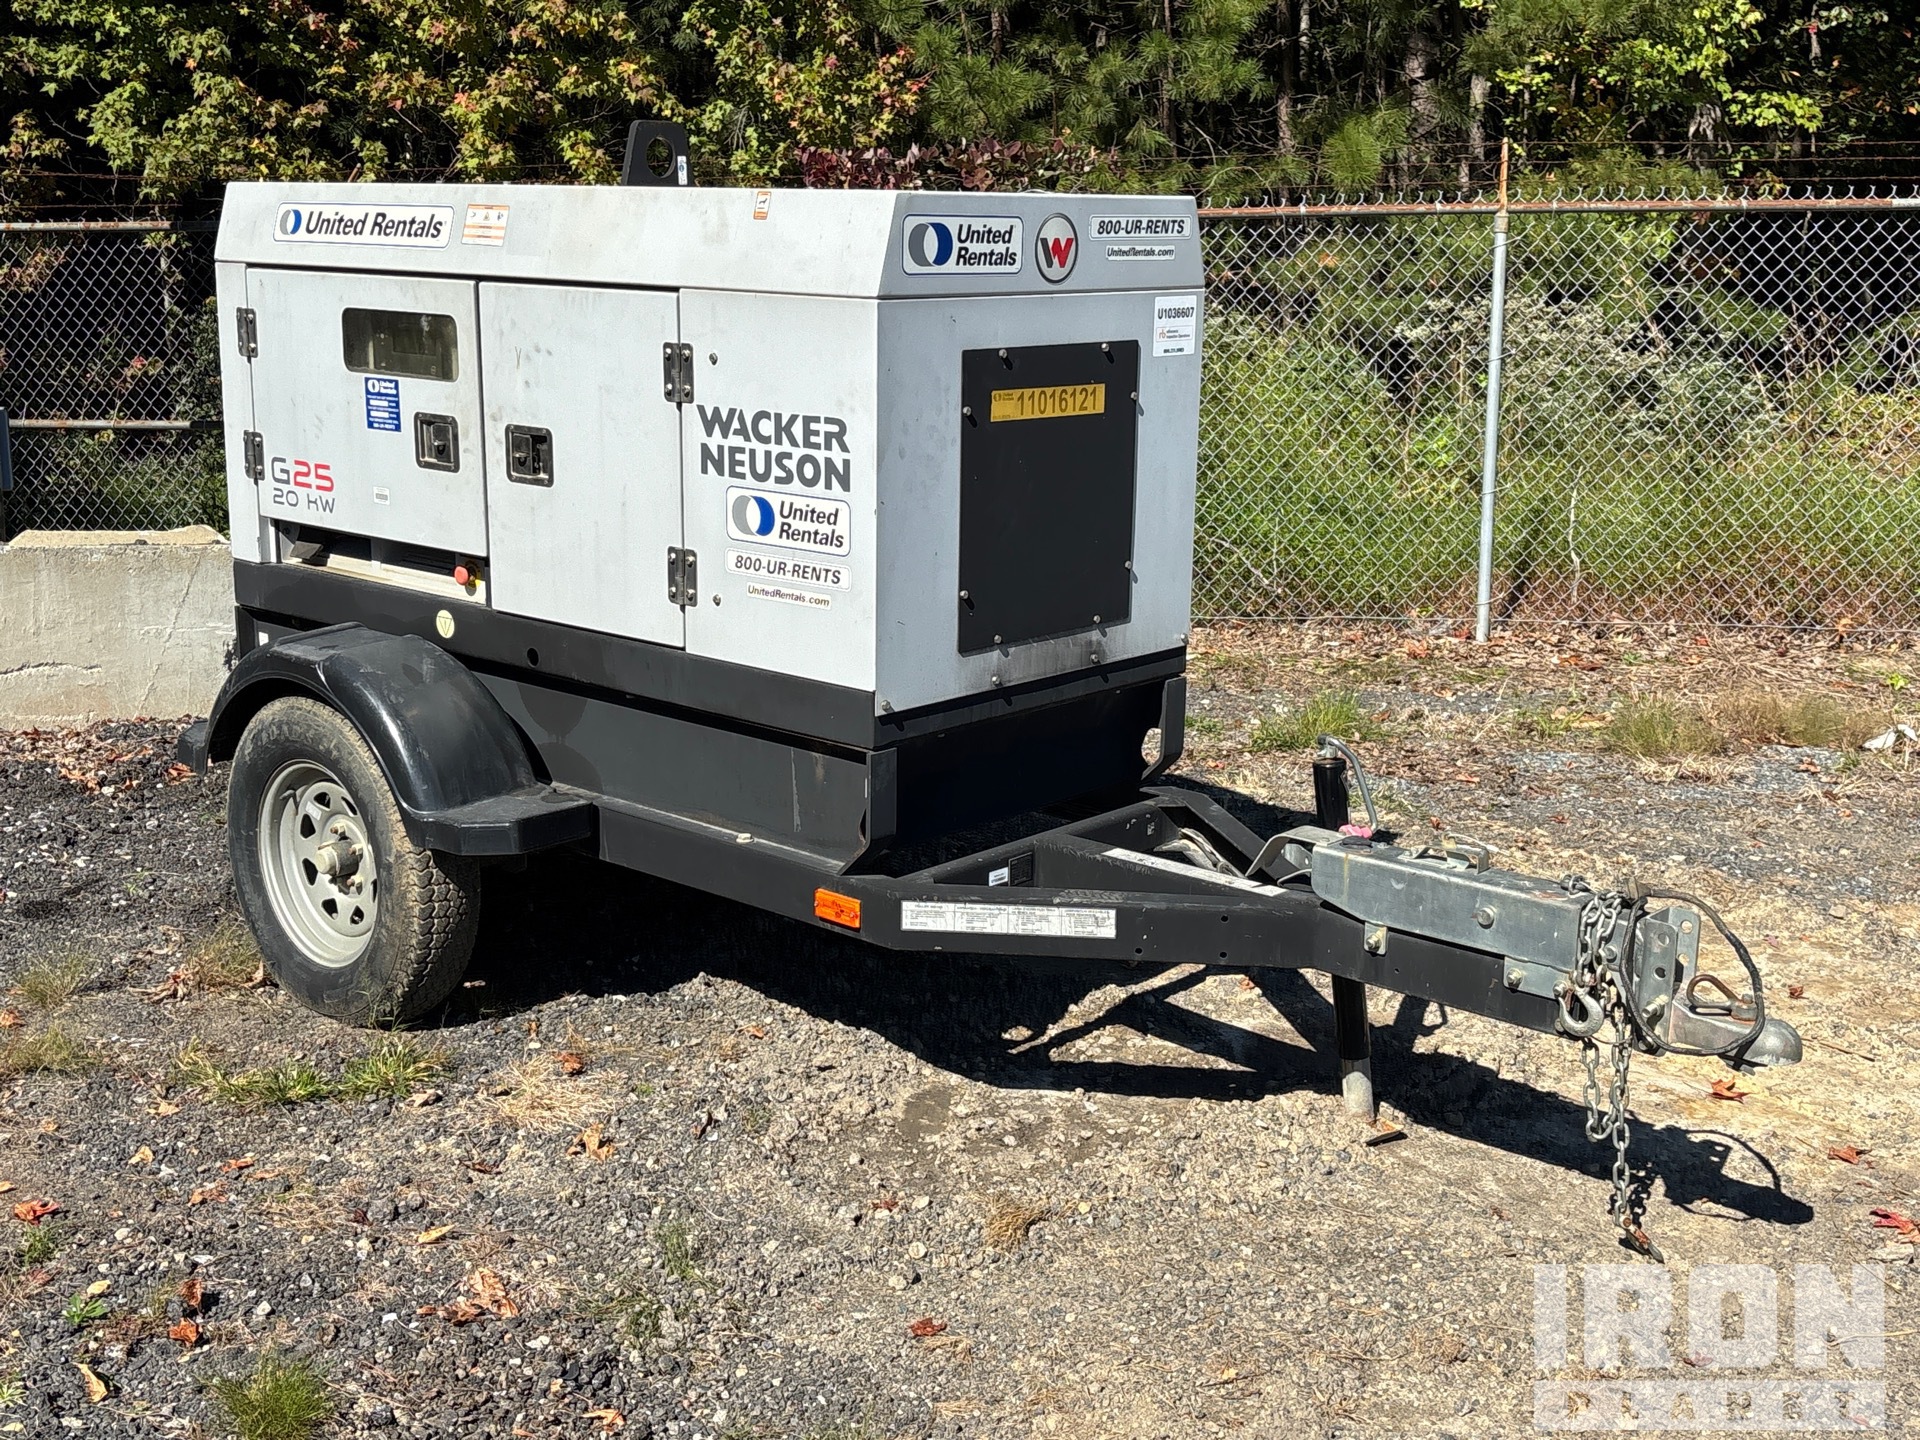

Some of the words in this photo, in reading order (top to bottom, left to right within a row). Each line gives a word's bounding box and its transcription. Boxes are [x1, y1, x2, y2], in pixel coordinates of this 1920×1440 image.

[306, 211, 369, 236] United
[369, 212, 443, 239] Rentals
[957, 224, 1014, 244] United
[1097, 219, 1185, 235] 800-UR-RENTS
[956, 246, 1018, 266] Rentals
[1107, 247, 1174, 257] UnitedRentals.com
[1157, 306, 1195, 320] U1036607
[1017, 386, 1097, 416] 11016121
[696, 404, 851, 454] WACKER
[271, 456, 335, 493] G25
[700, 442, 851, 493] NEUSON
[273, 487, 299, 508] 20
[779, 500, 839, 526] United
[778, 521, 844, 548] Rentals
[734, 555, 842, 585] 800-UR-RENTS
[747, 584, 830, 607] UnitedRentals.com
